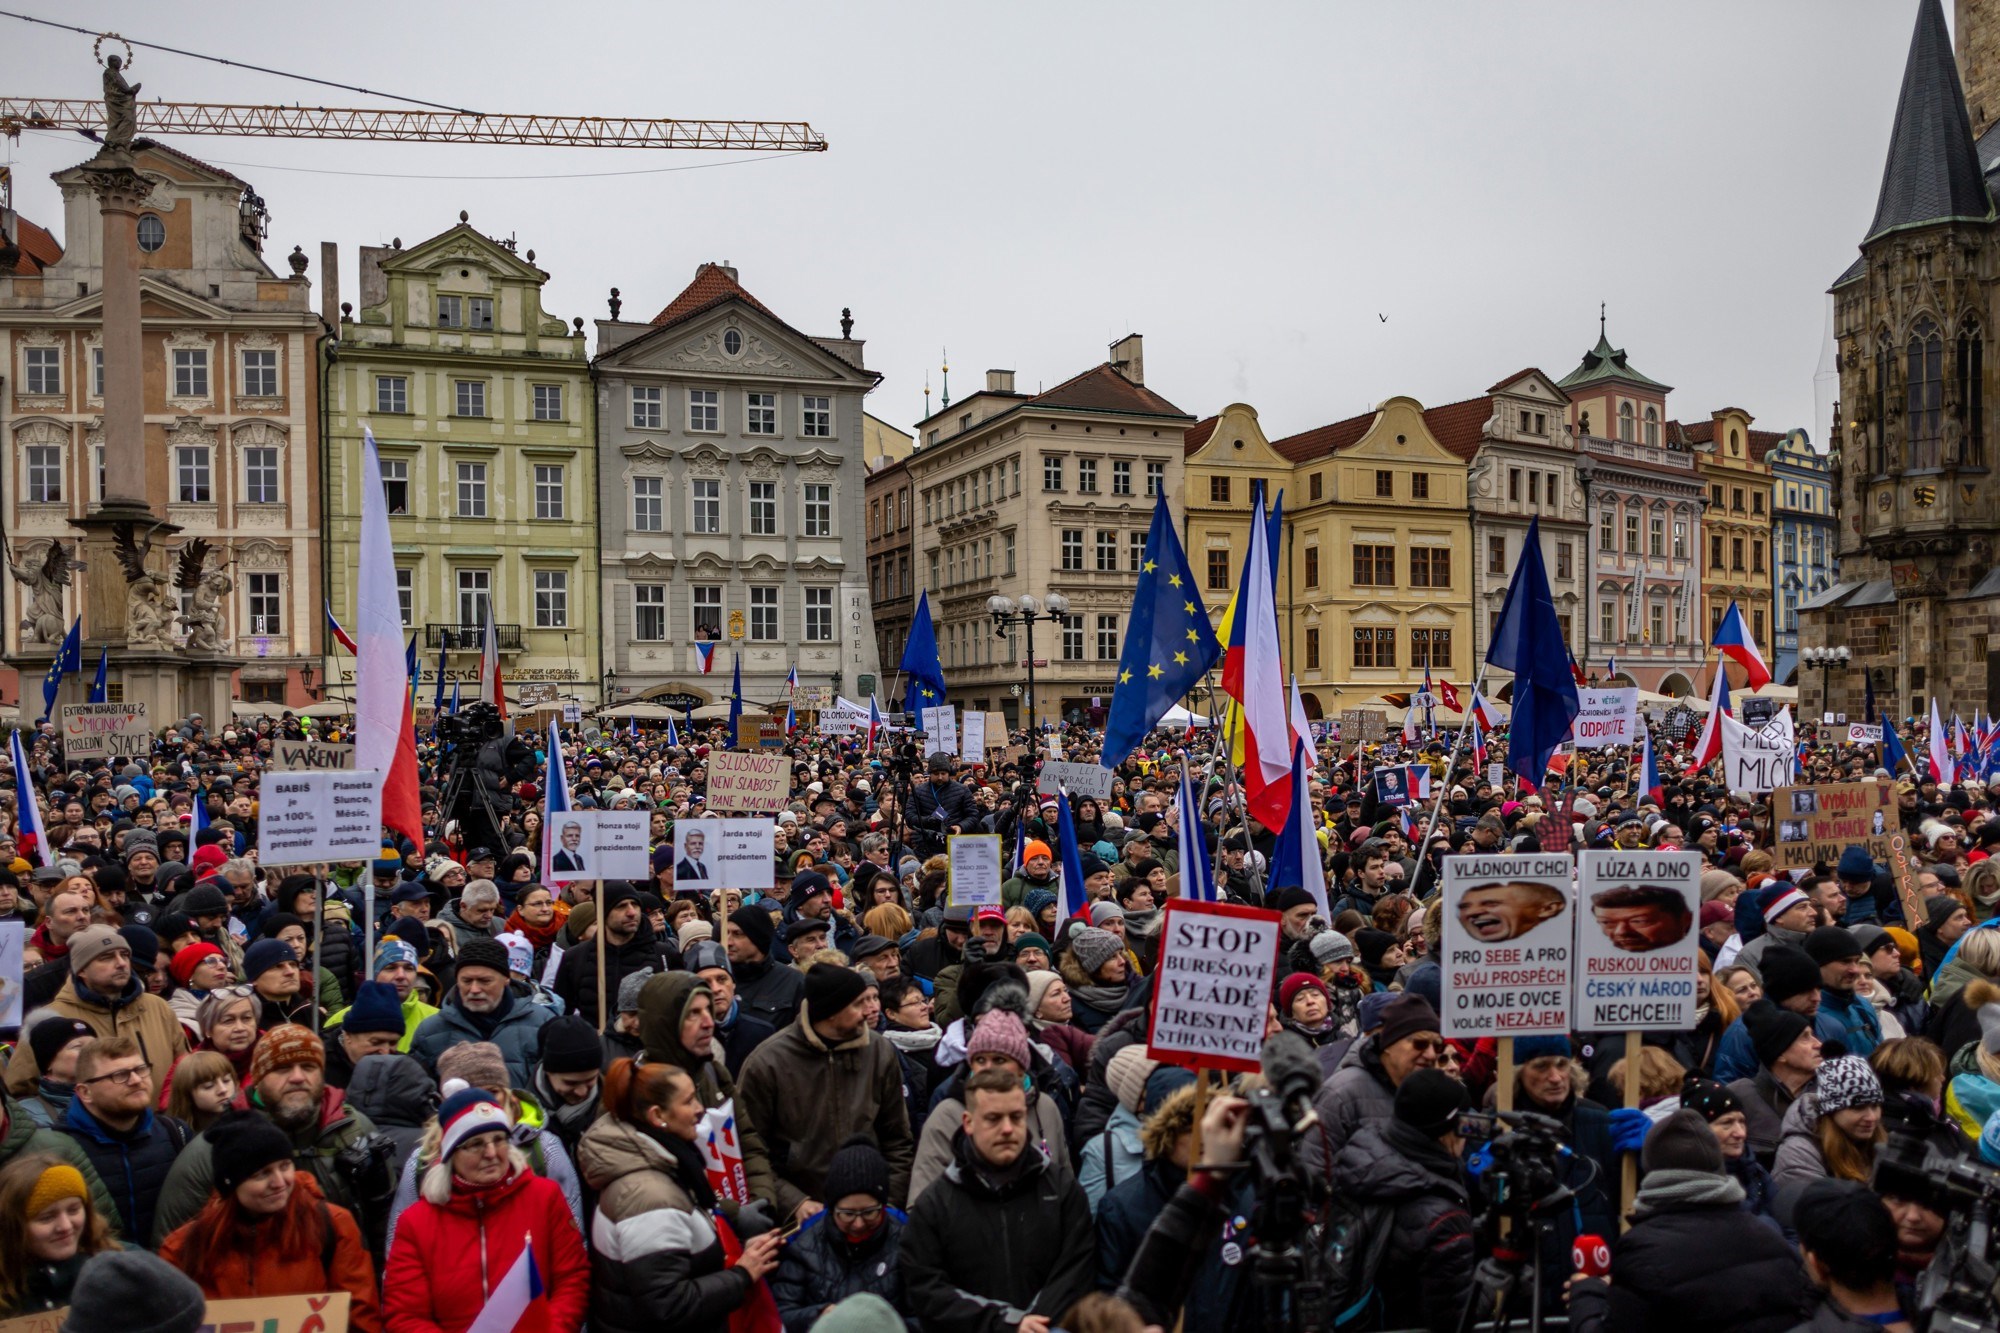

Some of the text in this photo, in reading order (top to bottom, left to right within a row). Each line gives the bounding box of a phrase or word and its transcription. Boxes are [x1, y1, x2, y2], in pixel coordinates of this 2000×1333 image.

[852, 597, 861, 663] HOTEL
[1354, 629, 1394, 640] CAFE
[1411, 630, 1449, 641] CAFE
[1083, 686, 1114, 694] STARB
[94, 703, 137, 715] KOHABITACE
[1587, 697, 1597, 705] ZA
[820, 710, 856, 720] OLOMOUC
[821, 723, 829, 731] JE
[835, 721, 849, 731] VÁMI
[66, 732, 147, 756] POSLEDNÍ ŠTACE
[281, 745, 353, 769] VAŘENÍ
[715, 753, 784, 774] SLUŠNOST
[1059, 764, 1097, 775] 36 LET
[275, 782, 311, 794] BABIŠ
[332, 782, 373, 791] Planeta
[710, 774, 781, 791] NENÍ SLABOST
[287, 798, 298, 807] je
[333, 795, 372, 805] Slunce,
[711, 794, 790, 811] PANE MACINKO!
[266, 811, 315, 822] na 100%
[333, 825, 363, 833] mléko
[597, 822, 641, 830] Honza stojí
[721, 830, 763, 839] Jarda stojí
[1814, 817, 1868, 840] DIPLOMACIE
[270, 839, 314, 851] premiér
[594, 843, 643, 852] prezidentem
[1784, 841, 1840, 866] MACINKA
[717, 853, 768, 862] prezidentem
[1454, 859, 1568, 877] VLÁDNOUT CHCI
[1641, 862, 1653, 877] A
[1657, 861, 1690, 878] DNO
[1891, 835, 1924, 932] OSTRAVA
[1177, 922, 1262, 954] STOP
[1453, 947, 1567, 964] PRO SEBE A PRO
[1587, 956, 1692, 972] RUSKOU ONUCI
[1166, 955, 1268, 981] BUREŠOVĚ
[1453, 966, 1566, 986] SVŮJ PROSPĚCH
[1170, 979, 1259, 1008] VLÁDĚ
[1586, 978, 1692, 998] ČESKÝ NÁROD
[1457, 991, 1562, 1009] O MOJE OVCE
[1159, 1006, 1261, 1035] TRESTNĚ
[1453, 1008, 1566, 1029] VOLIČE NEZÁJEM
[1594, 1003, 1682, 1022] NECHCE!!!
